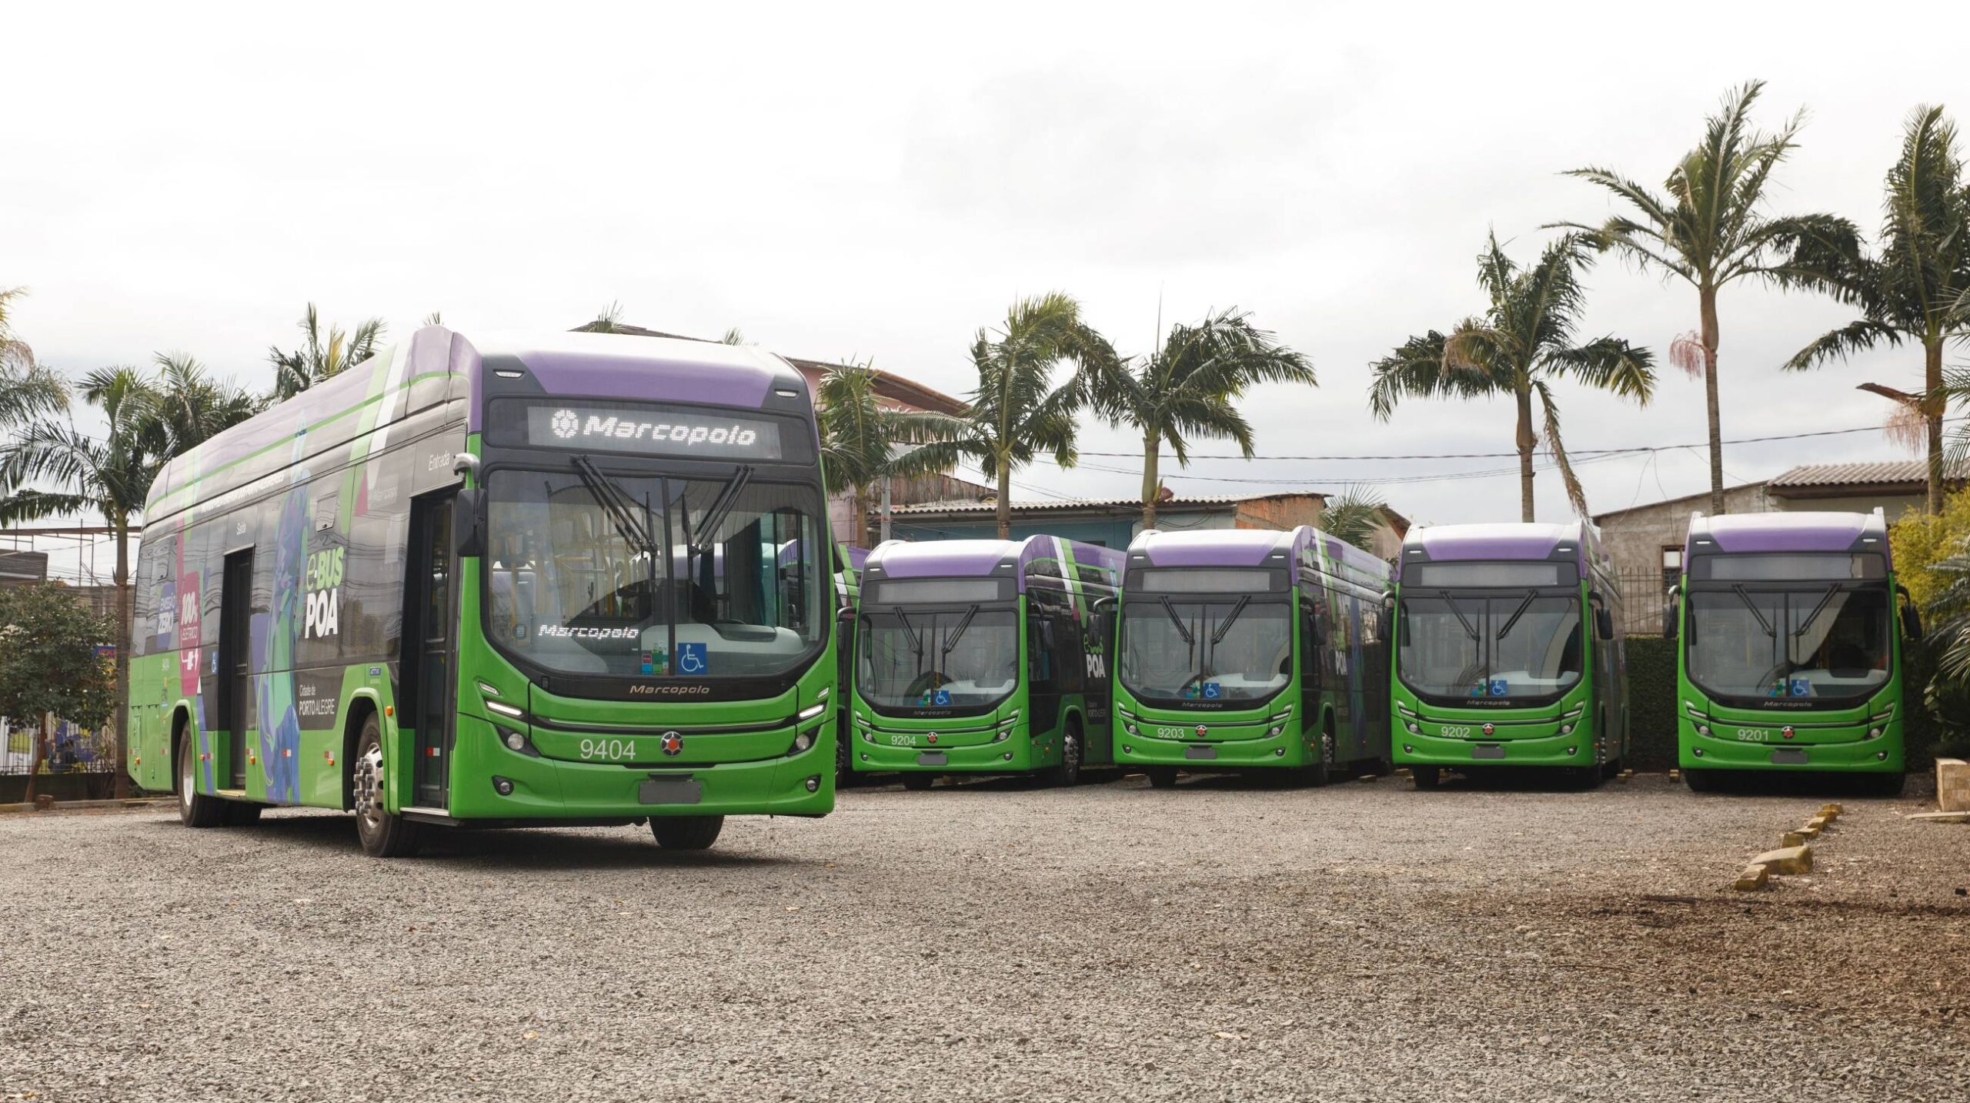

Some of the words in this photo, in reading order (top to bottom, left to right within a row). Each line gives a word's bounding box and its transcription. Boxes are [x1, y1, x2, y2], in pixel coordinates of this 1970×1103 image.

[583, 415, 756, 446] Marcopolo
[428, 449, 451, 471] Entrada
[306, 546, 345, 592] e-BUS
[181, 591, 198, 626] 100%
[305, 588, 338, 639] POA
[538, 624, 639, 639] Marcopolo
[1085, 654, 1106, 678] POA
[629, 684, 711, 696] Marcopolo
[299, 700, 316, 716] PORTO
[316, 698, 335, 715] ALEGRE
[891, 735, 917, 746] 9204
[1157, 728, 1185, 739] 9203
[1441, 726, 1471, 738] 9202
[1737, 729, 1769, 742] 9201
[580, 739, 636, 760] 9404
